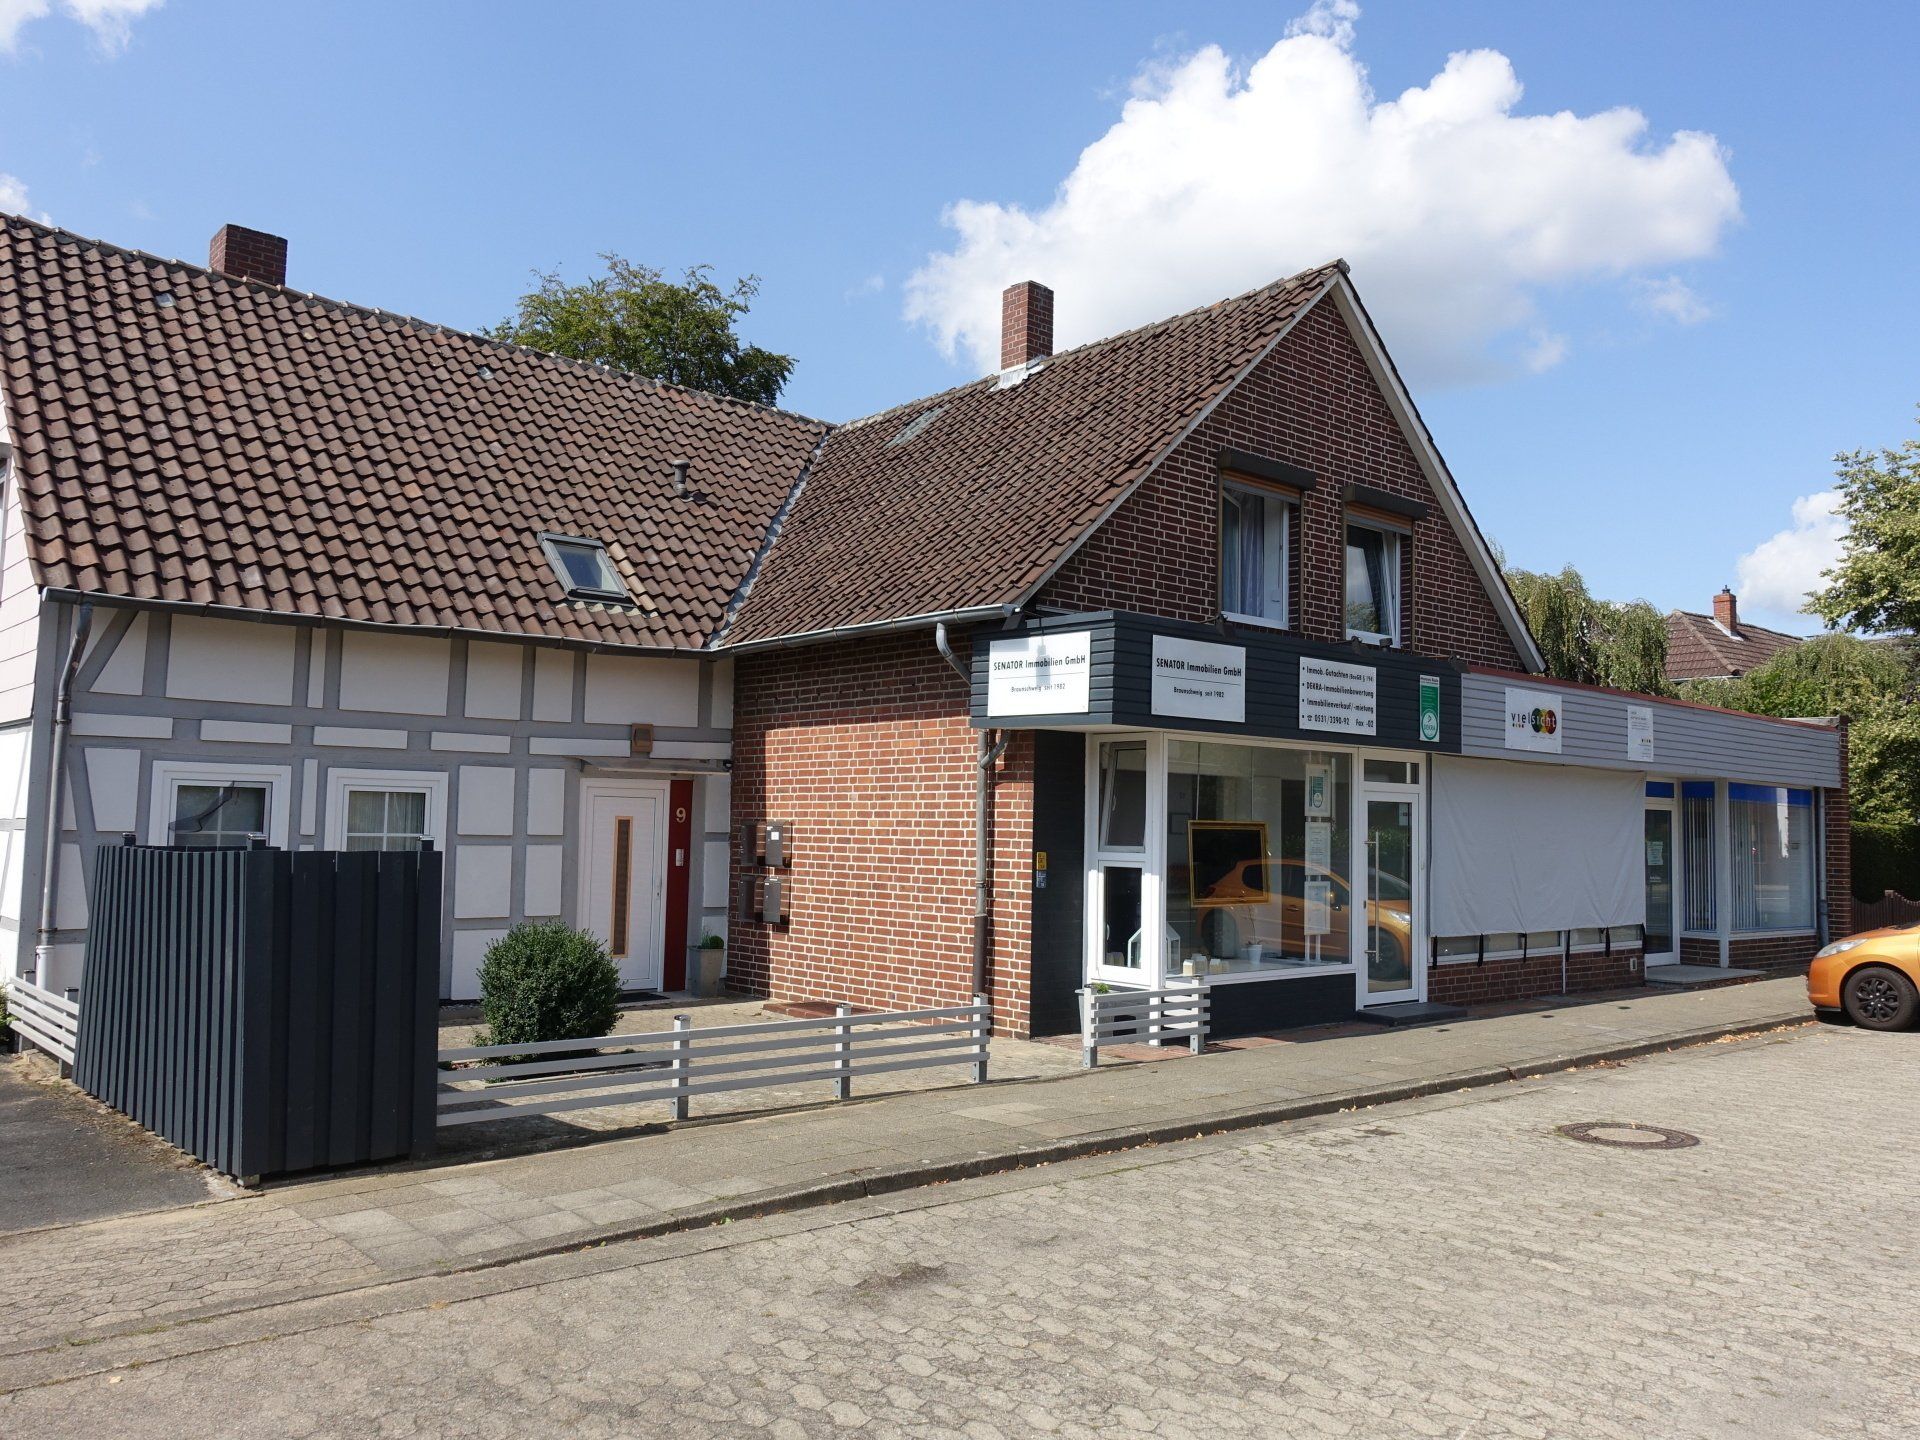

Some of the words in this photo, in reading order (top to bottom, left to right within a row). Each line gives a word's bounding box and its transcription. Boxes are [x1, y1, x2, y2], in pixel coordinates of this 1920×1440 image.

[993, 660, 1023, 671] SENATOR
[1025, 657, 1063, 668] Immobilien
[1065, 655, 1086, 665] GmbH
[1156, 658, 1185, 670] SENATOR
[1187, 662, 1221, 675] Immobilien
[1223, 667, 1242, 677] GmbH
[1306, 665, 1324, 676] Immob.
[1325, 668, 1349, 679] Gutachten
[1011, 684, 1041, 693] Braunschweig
[1173, 686, 1203, 697] Braunschweig
[1213, 690, 1225, 698] 1982
[1306, 681, 1374, 699] DEKRA-Immobilienbewertung
[1355, 718, 1364, 727] Fax
[676, 807, 686, 823] 9
